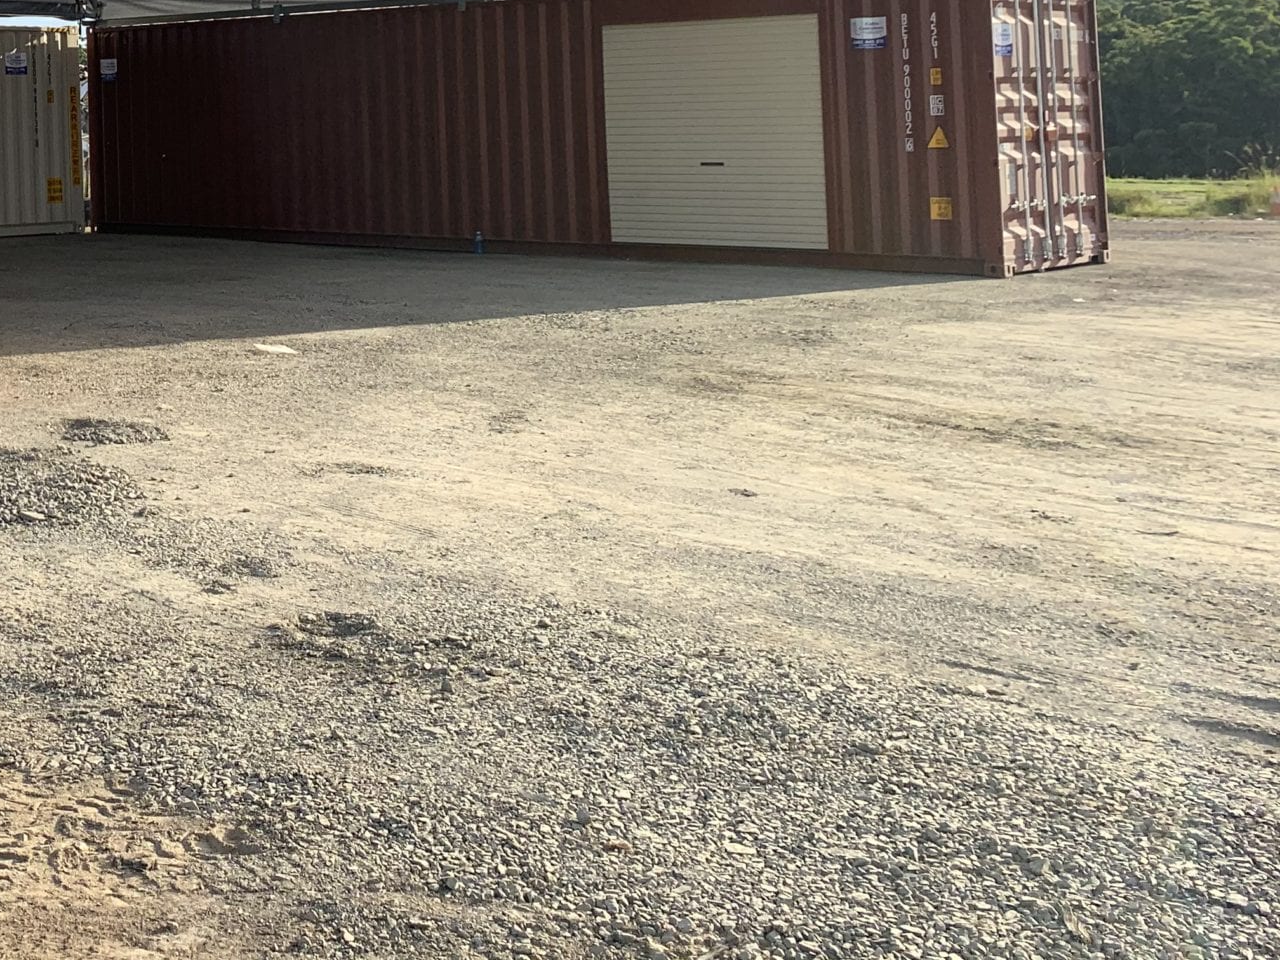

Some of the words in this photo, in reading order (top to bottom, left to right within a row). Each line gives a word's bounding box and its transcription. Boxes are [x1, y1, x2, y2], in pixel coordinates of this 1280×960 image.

[901, 13, 910, 60] BETU
[930, 12, 938, 59] 45G1
[903, 64, 912, 134] 900002
